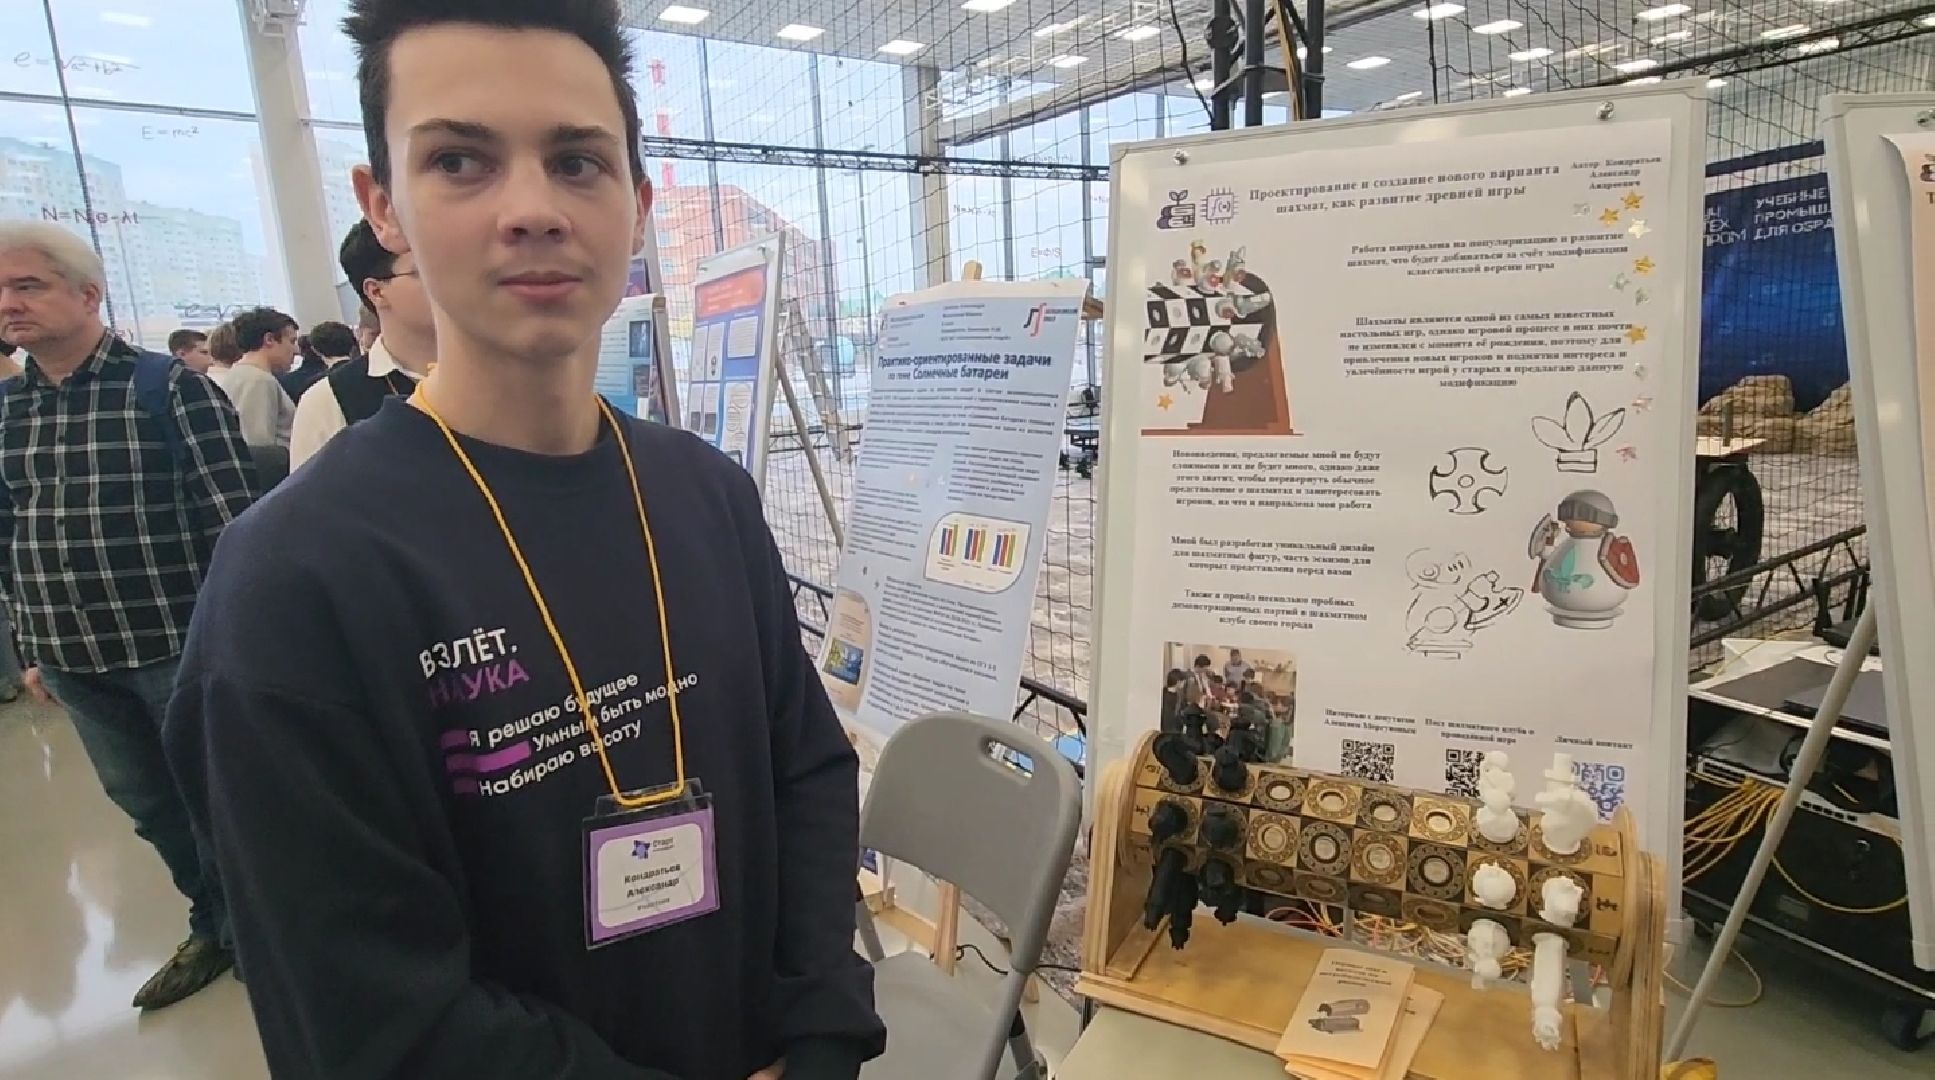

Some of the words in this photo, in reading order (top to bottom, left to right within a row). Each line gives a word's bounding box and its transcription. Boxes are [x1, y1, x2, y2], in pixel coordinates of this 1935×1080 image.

[1250, 182, 1357, 201] Проектирование
[1361, 181, 1369, 189] и
[1374, 176, 1433, 189] создание
[1437, 172, 1485, 183] нового
[1490, 166, 1560, 181] варианта
[1276, 202, 1328, 213] шахмат,
[1332, 200, 1355, 208] как
[1359, 194, 1421, 209] развитие
[1425, 188, 1483, 204] древней
[1487, 186, 1526, 199] игры
[1756, 187, 1826, 209] УЧЕБНЫЕ
[1753, 224, 1788, 240] ДЛЯ
[1351, 244, 1386, 254] Работа
[1389, 242, 1450, 253] направлена
[1469, 237, 1557, 248] популяризацию
[1571, 233, 1624, 244] развитие
[1411, 255, 1438, 265] будет
[1441, 252, 1503, 262] добиваться
[1520, 248, 1543, 257] счёт
[1407, 264, 1481, 275] классической
[1483, 264, 1522, 273] версии
[1525, 262, 1554, 272] игры
[1355, 317, 1407, 325] Шахматы
[1464, 313, 1496, 322] одной
[1340, 330, 1401, 338] настольных
[1403, 329, 1426, 338] игр,
[1468, 325, 1512, 336] игровой
[1515, 325, 1560, 334] процесс
[1476, 338, 1487, 346] её
[1490, 340, 1547, 349] рождения,
[1550, 338, 1597, 346] поэтому
[1600, 337, 1621, 345] для
[878, 352, 1000, 369] Практико-ориентированные
[1003, 354, 1052, 369] задачи
[1343, 356, 1410, 365] привлечения
[1449, 354, 1493, 364] игроков
[1562, 351, 1614, 360] интереса
[913, 367, 959, 379] Солнечные
[960, 365, 1009, 381] батареи
[1346, 367, 1415, 377] увлечённости
[1418, 365, 1449, 376] игрой
[1452, 367, 1458, 375] у
[1461, 366, 1500, 375] старых
[1514, 365, 1575, 375] предлагаю
[1578, 364, 1624, 373] данную
[1242, 452, 1309, 460] предлагаемые
[1312, 450, 1337, 459] мной
[1354, 450, 1380, 461] будут
[1257, 461, 1282, 472] будет
[1238, 473, 1266, 482] чтобы
[1268, 476, 1328, 485] перевернуть
[1258, 500, 1314, 509] направлена
[1339, 500, 1371, 511] работа
[1171, 536, 1196, 544] Мной
[1199, 536, 1218, 545] был
[1219, 539, 1273, 548] разработан
[1274, 542, 1337, 550] уникальный
[1248, 551, 1280, 562] фигур,
[1188, 562, 1227, 571] которых
[1230, 564, 1294, 572] представлена
[1296, 567, 1324, 576] перед
[1184, 589, 1212, 598] Также
[1222, 593, 1255, 602] провёл
[1258, 595, 1308, 603] несколько
[1311, 597, 1354, 606] пробных
[1263, 608, 1298, 617] партий
[1309, 611, 1367, 620] шахматном
[1219, 615, 1246, 625] клубе
[1280, 621, 1313, 630] города
[419, 628, 517, 678] ВЗЛЁТ.
[429, 659, 529, 705] НАУКА
[600, 698, 642, 722] быть
[645, 673, 698, 704] моно
[488, 706, 560, 748] решаю
[1554, 735, 1593, 745] Личный
[1596, 741, 1633, 749] контакт
[479, 750, 574, 796] Набираю
[579, 719, 641, 757] высоту
[625, 864, 681, 883] Кондратьев
[627, 878, 680, 898] Александр
